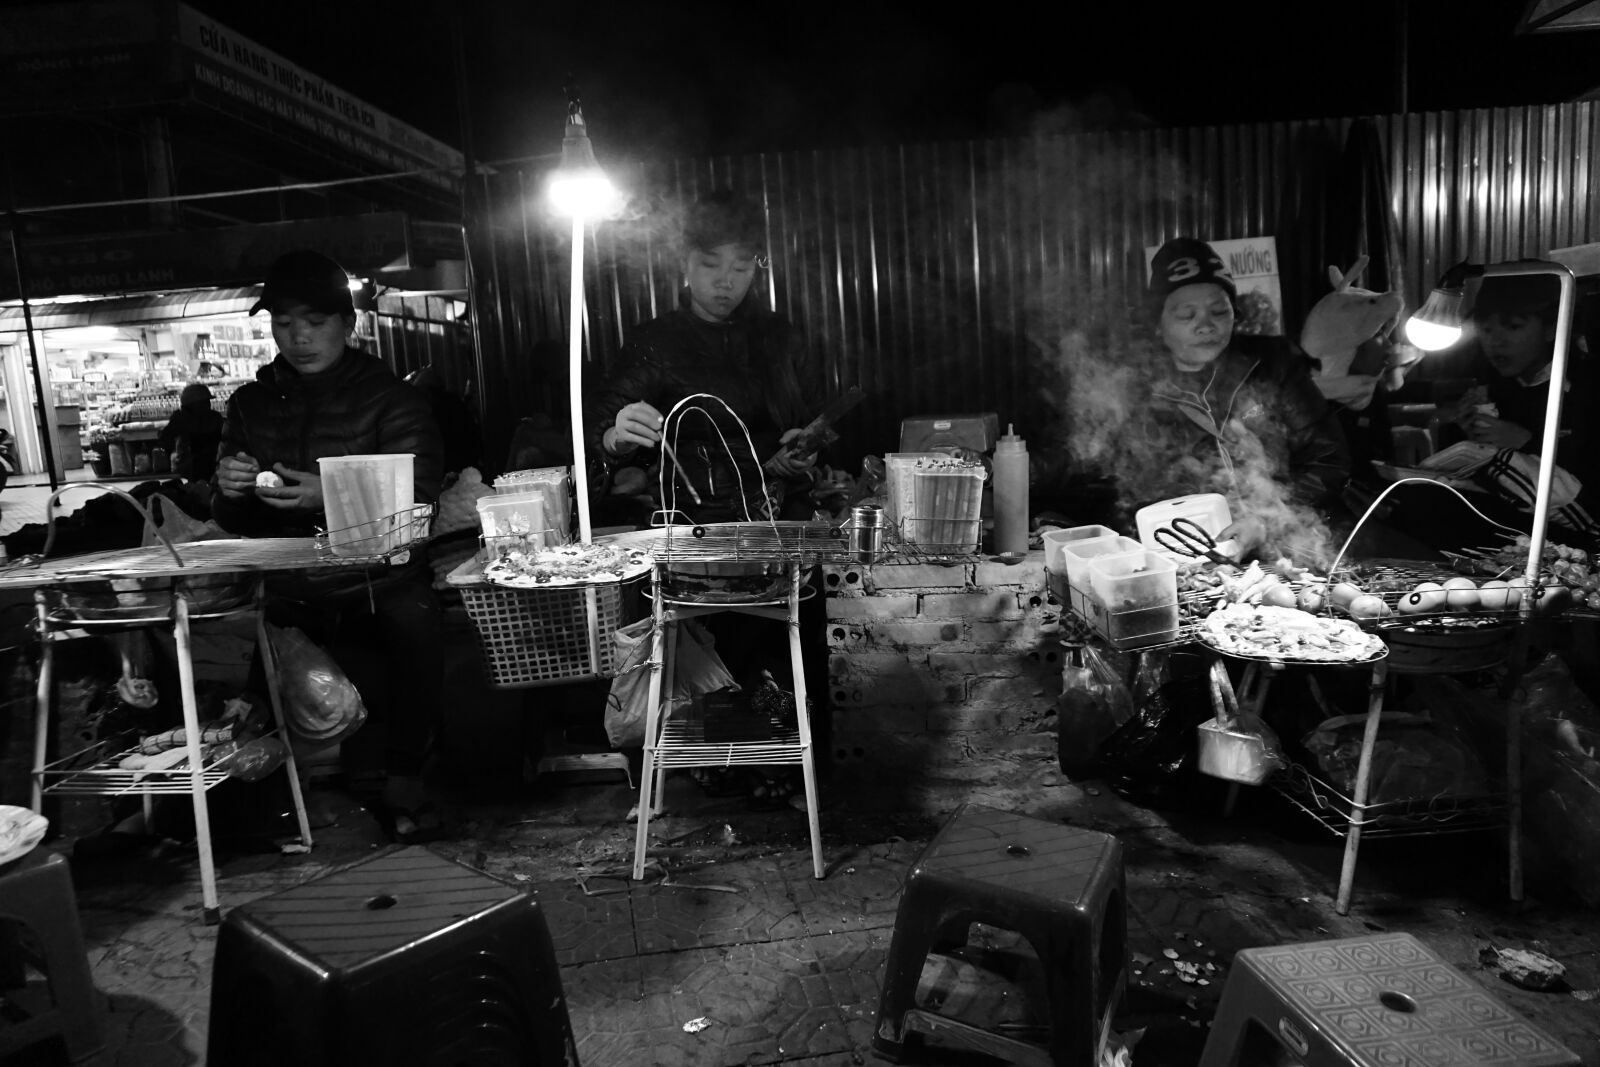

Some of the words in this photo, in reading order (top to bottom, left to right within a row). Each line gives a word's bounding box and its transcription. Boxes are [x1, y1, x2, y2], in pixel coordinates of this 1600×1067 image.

[200, 22, 229, 57] CỬA
[233, 40, 269, 76] HÀNG
[1229, 244, 1273, 275] NƯỚNG
